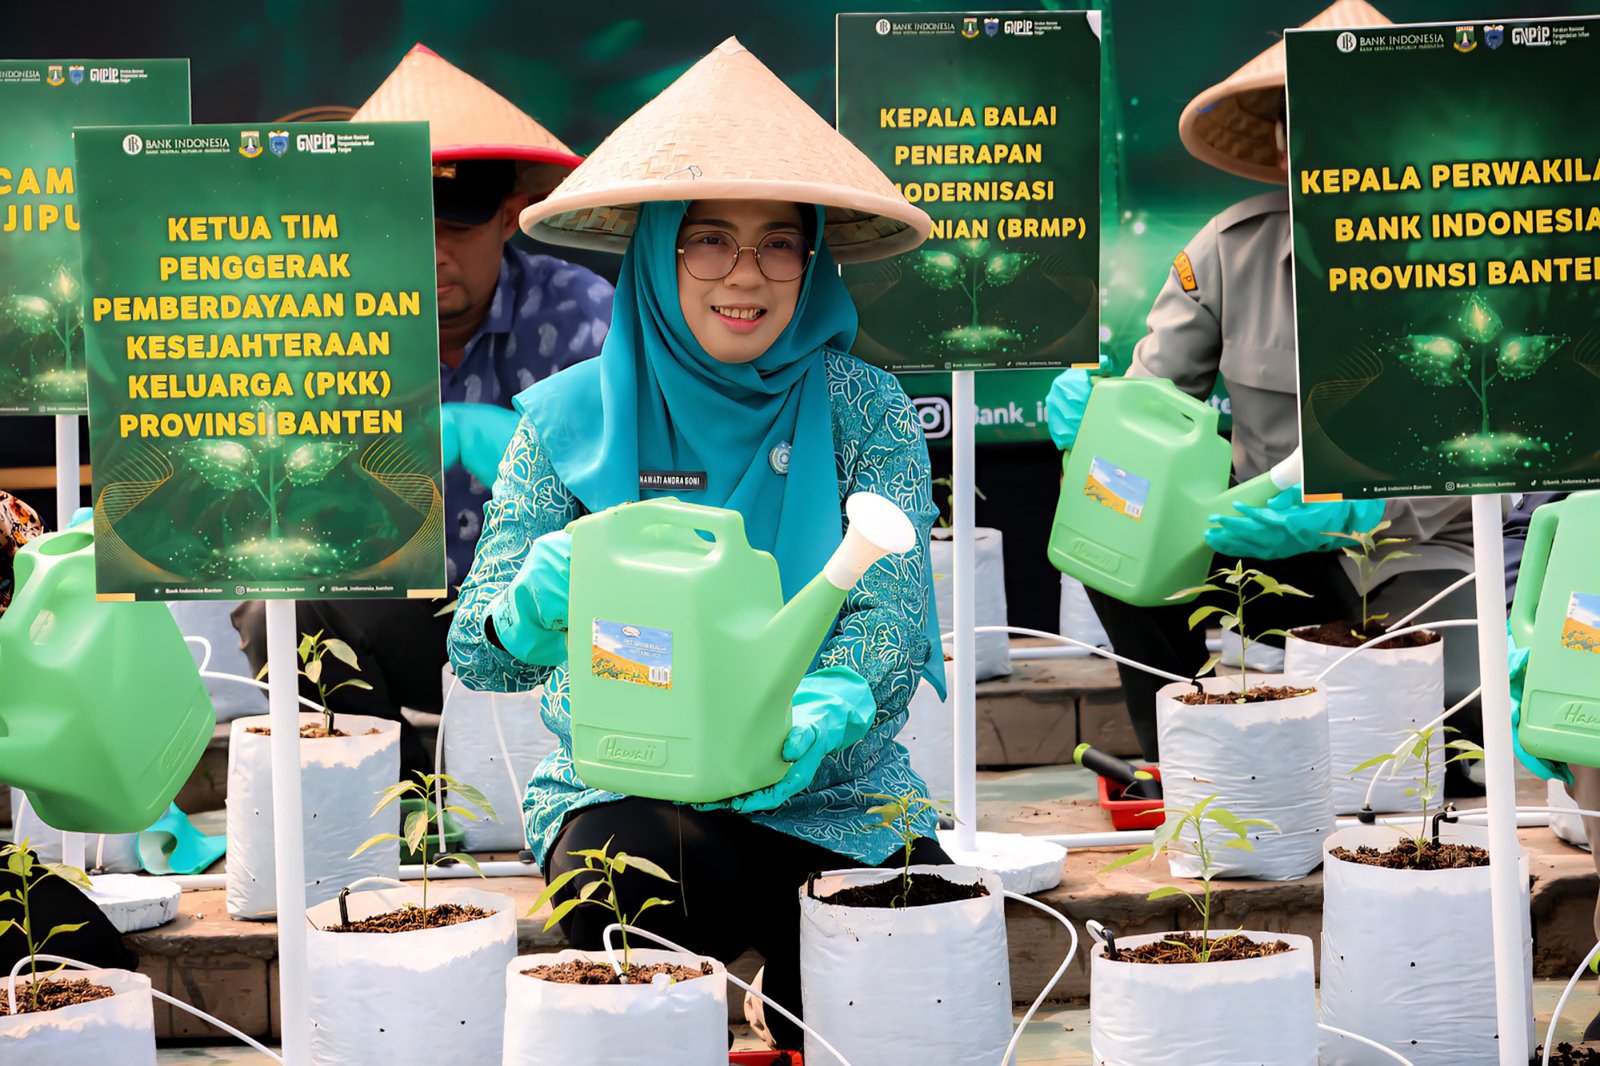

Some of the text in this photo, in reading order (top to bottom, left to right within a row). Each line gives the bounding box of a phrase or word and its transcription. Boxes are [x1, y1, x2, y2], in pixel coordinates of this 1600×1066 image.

[892, 22, 955, 31] BANK INDONESIA
[1360, 33, 1444, 47] BANK INDONESIA
[880, 105, 1057, 128] KEPALA BALAI
[145, 138, 230, 149] BANK INDONESIA
[895, 143, 1042, 165] PENERAPAN
[896, 180, 1055, 203] ODERNISASI
[1301, 165, 1422, 194] KEPALA
[167, 213, 339, 242] KETUA TIM
[997, 216, 1087, 241] (BRMP)
[1334, 207, 1600, 243] BANK INDONESIA
[160, 253, 351, 281] PENGGERAK
[1328, 261, 1476, 292] PROVINSI
[93, 291, 420, 322] PEMBERDAYAAN DAN
[126, 331, 390, 360] KESEJAHTERAAN
[128, 370, 392, 399] KELUARGA (PKK)
[120, 409, 403, 438] PROVINSI BANTEN
[975, 400, 1048, 427] ank_i
[663, 476, 684, 485] ANDRA
[684, 476, 700, 486] SONI
[605, 737, 657, 761] Hawaii
